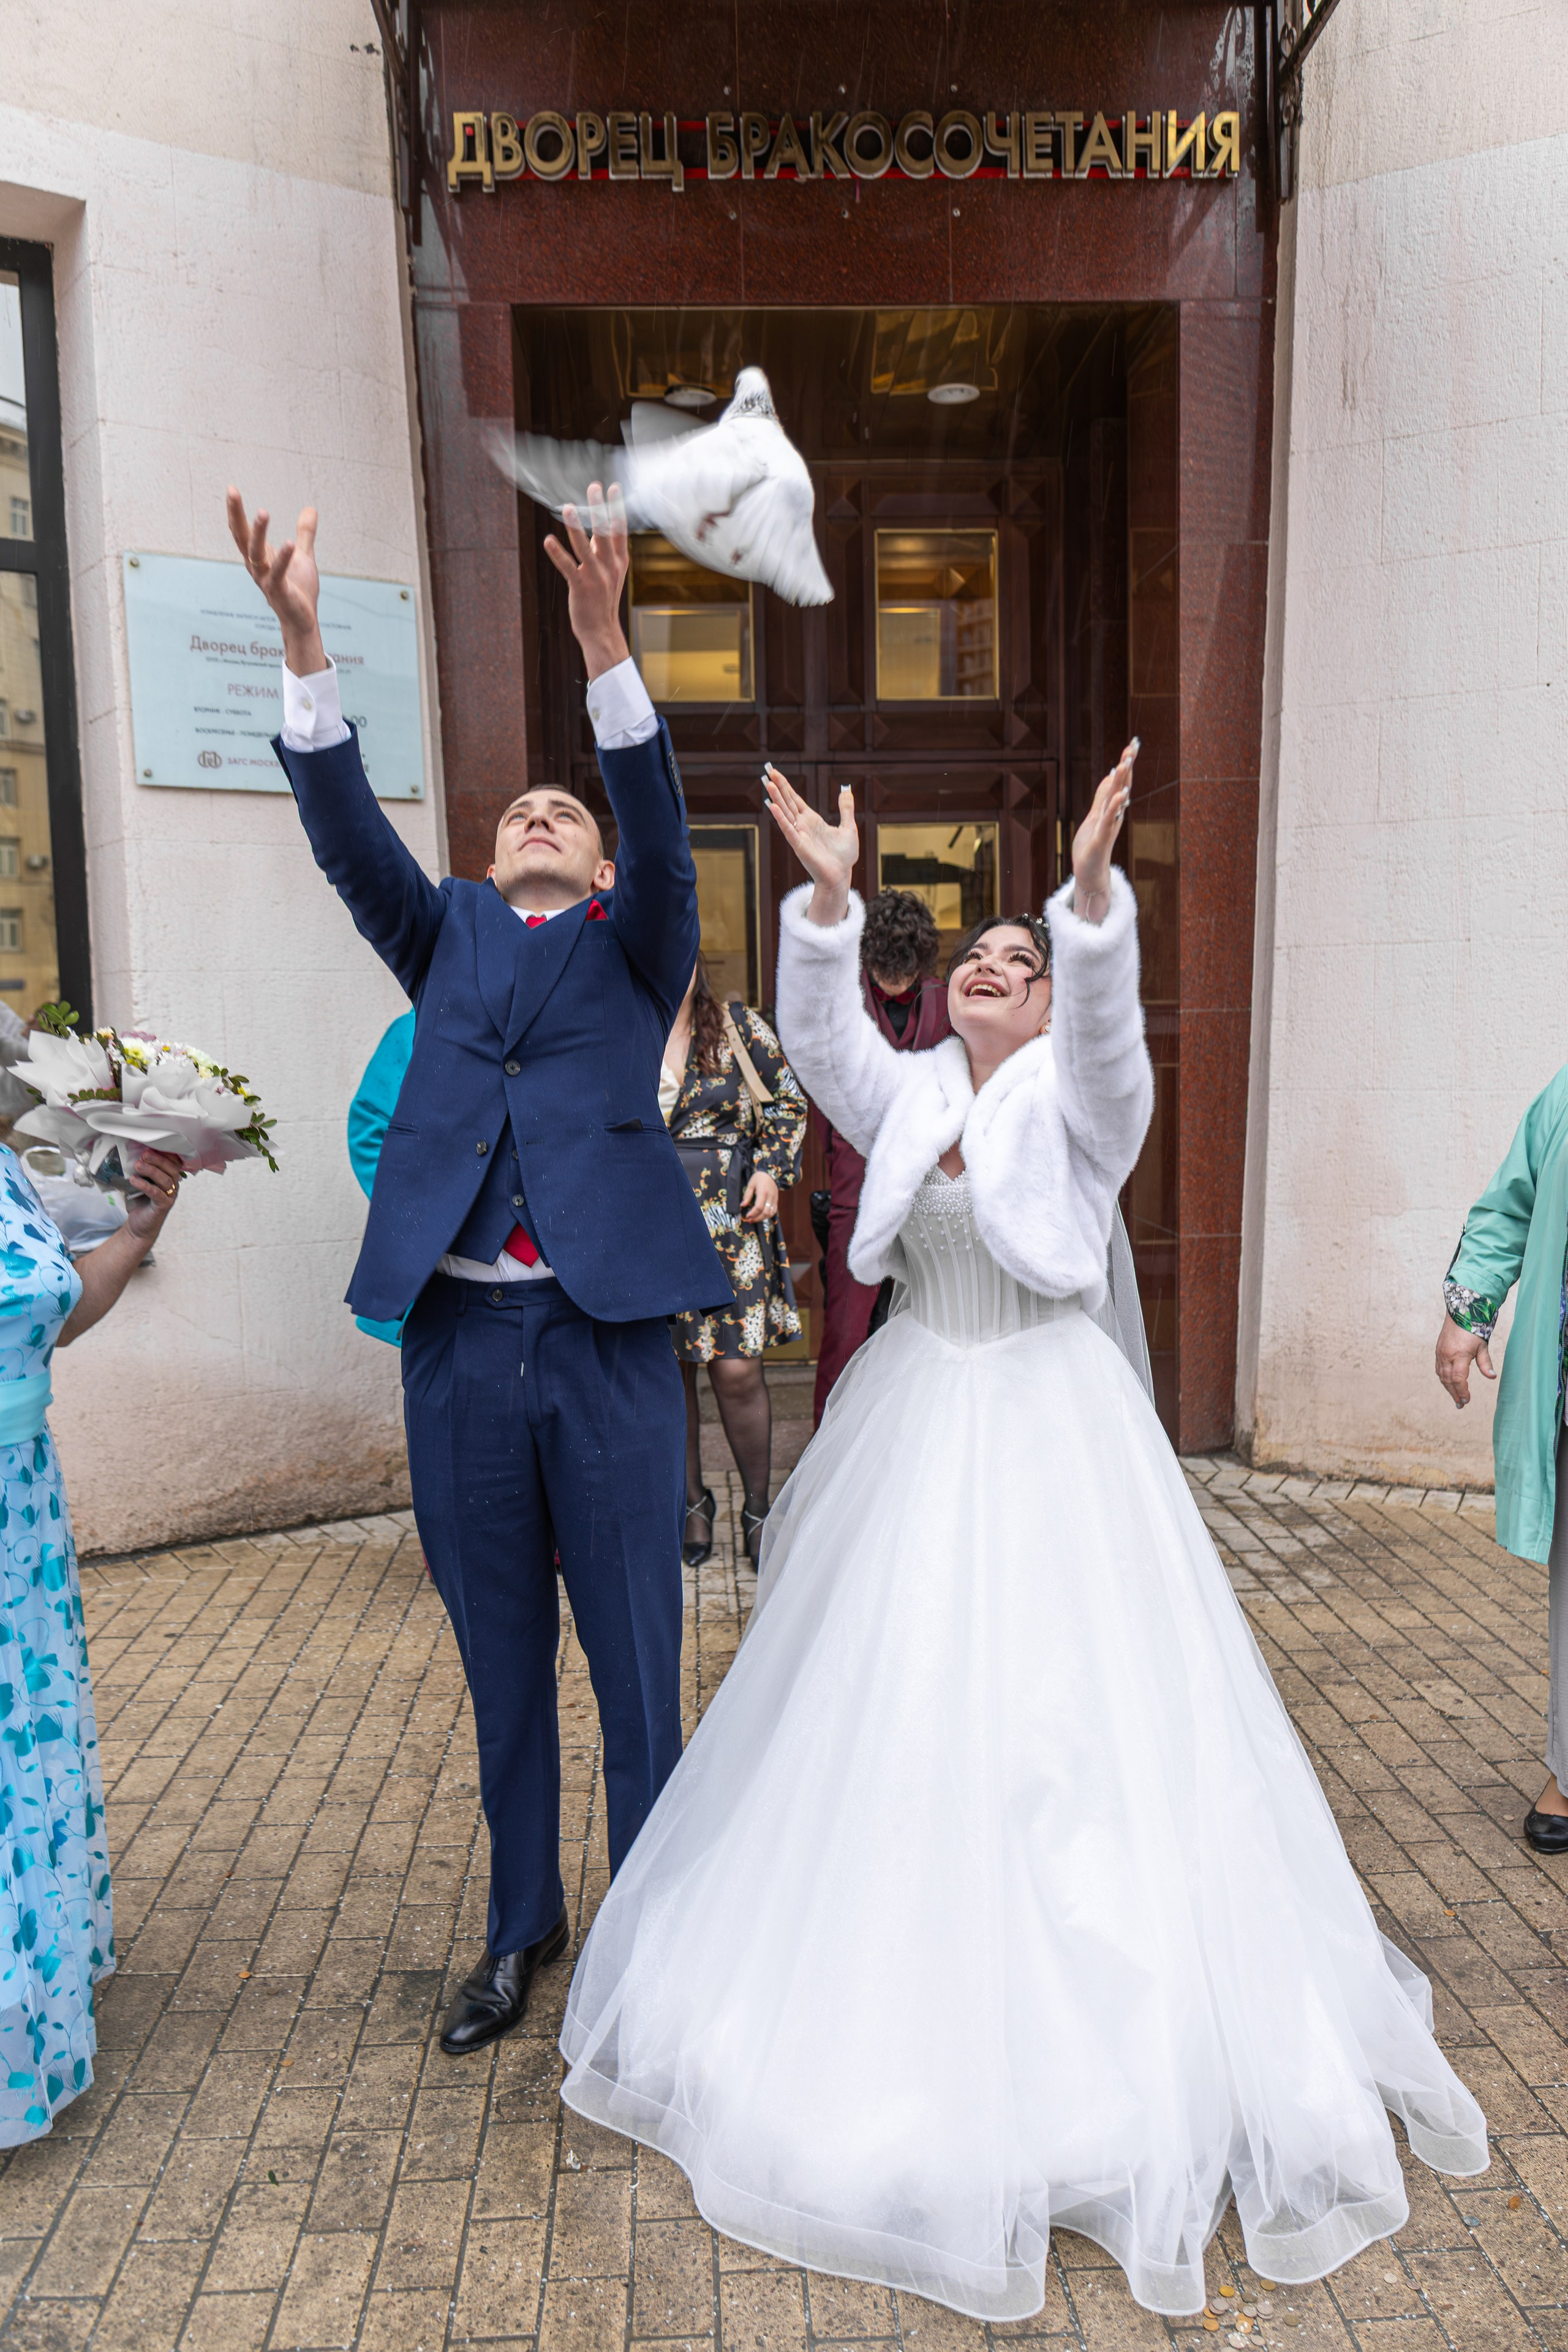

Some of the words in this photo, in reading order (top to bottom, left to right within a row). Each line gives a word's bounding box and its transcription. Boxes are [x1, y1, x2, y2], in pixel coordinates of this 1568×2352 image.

[447, 111, 684, 192] ДВОРЕЦ
[706, 109, 1240, 179] БРАКОСОЧЕТАНИЯ
[190, 635, 247, 656] Дворец
[227, 683, 279, 699] РЕЖИМ
[227, 757, 248, 766] ЗАГС
[249, 759, 282, 767] МОСКВ
